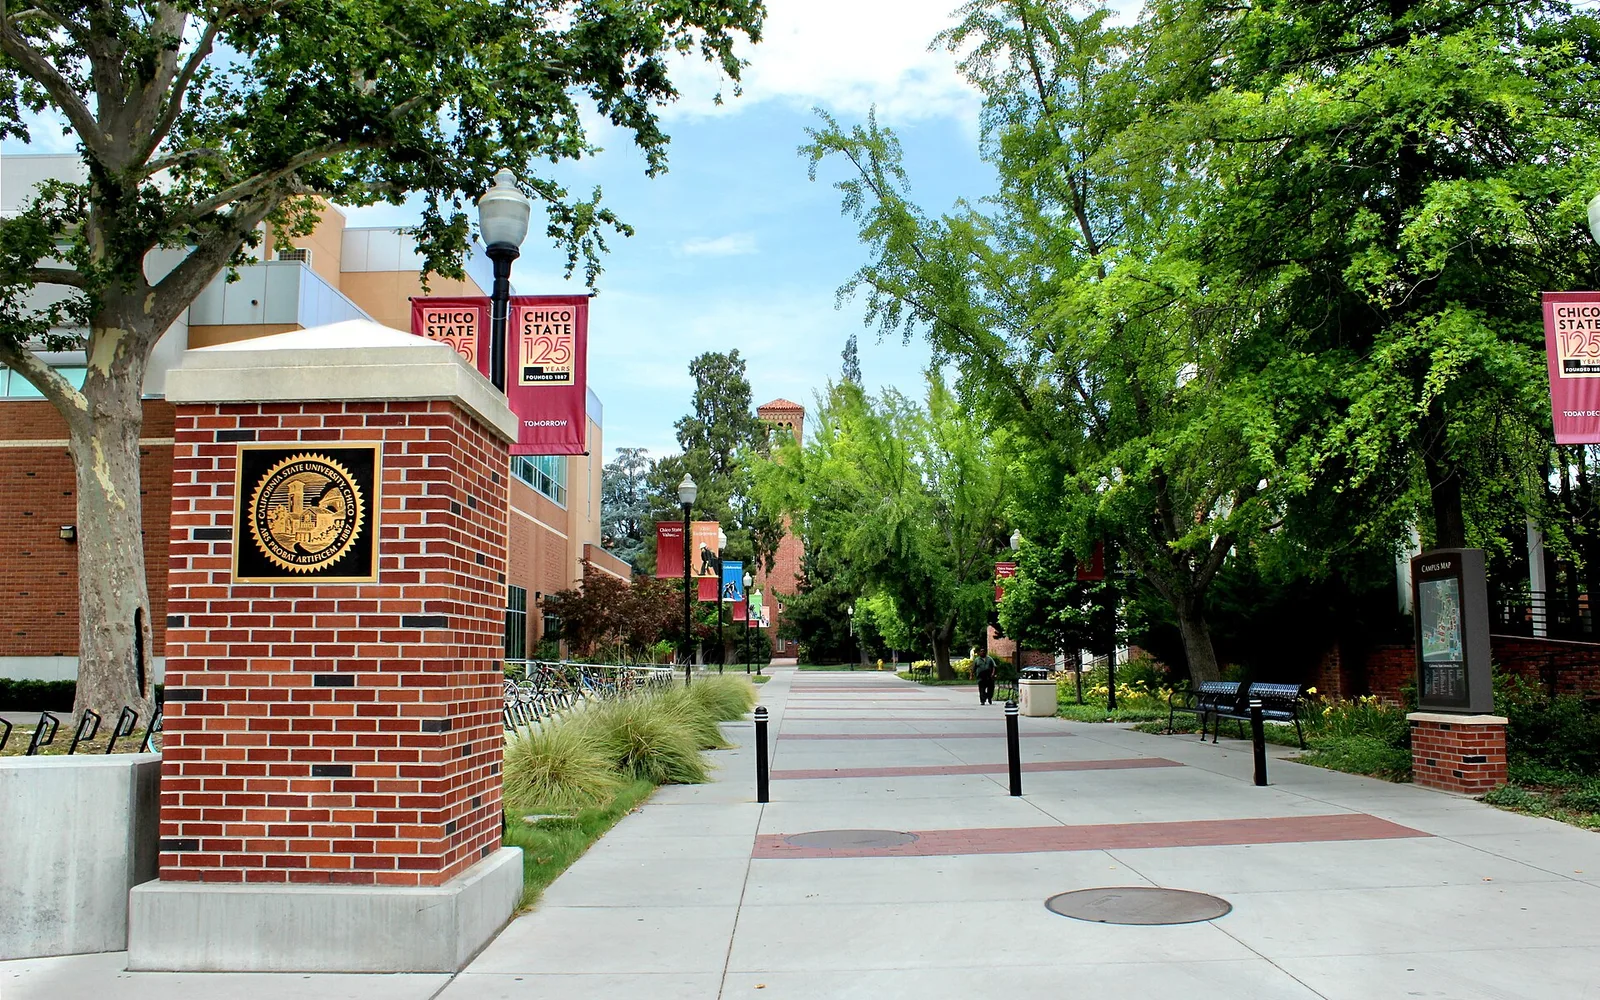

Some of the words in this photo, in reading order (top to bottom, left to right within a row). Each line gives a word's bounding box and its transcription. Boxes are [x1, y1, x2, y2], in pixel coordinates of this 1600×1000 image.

[427, 312, 474, 324] CHICO
[524, 311, 571, 323] CHICO
[1557, 307, 1600, 318] CHICO
[524, 324, 571, 335] STATE
[1559, 319, 1600, 330] STATE
[427, 325, 474, 337] STATE
[1560, 331, 1600, 357] 125
[524, 336, 571, 365] 125
[258, 475, 283, 519] CALIFORNIA
[281, 463, 304, 478] STATE
[343, 489, 355, 516] CHICO
[340, 524, 353, 542] 1887
[260, 527, 271, 543] ARS
[268, 542, 295, 562] PROBAT
[296, 545, 338, 563] ARTIFICEM
